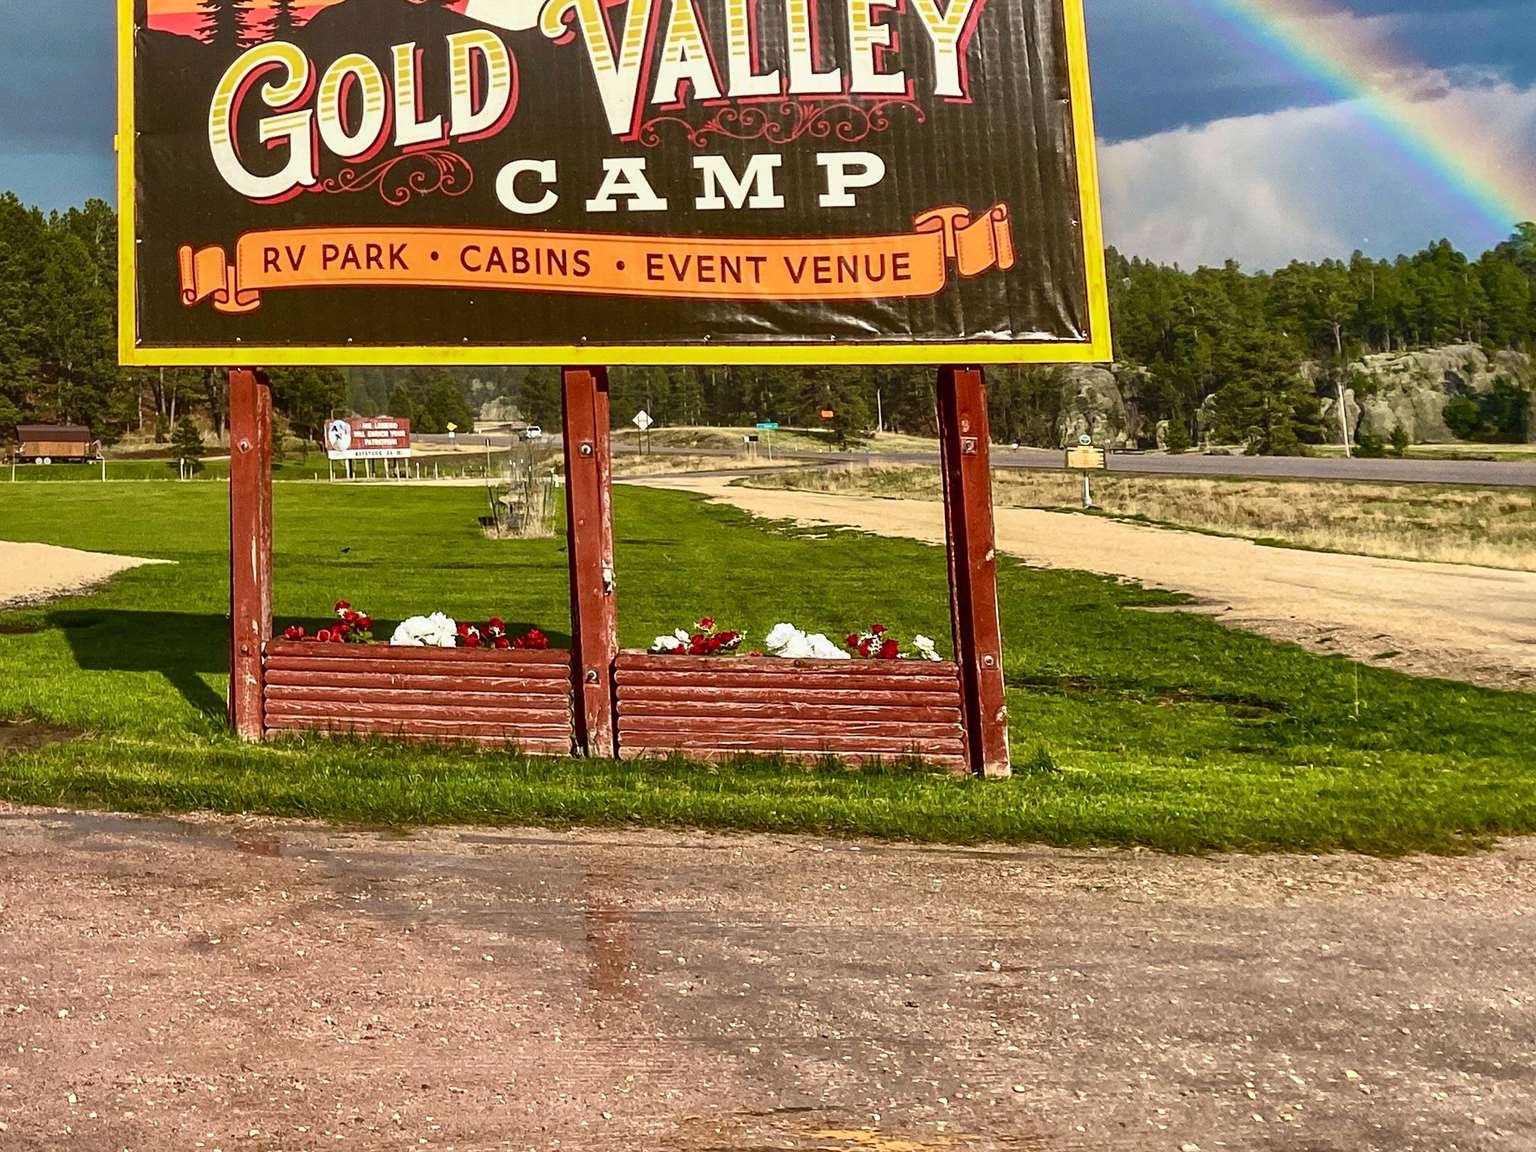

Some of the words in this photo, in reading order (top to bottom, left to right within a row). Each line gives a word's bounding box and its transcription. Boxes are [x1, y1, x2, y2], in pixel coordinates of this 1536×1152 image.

[208, 28, 518, 203] GOLD
[495, 151, 886, 215] CAMP
[263, 244, 307, 274] RV
[321, 242, 410, 271] PARK
[459, 244, 592, 278] CABINS
[645, 252, 768, 284] EVENT
[783, 252, 913, 285] VENUE
